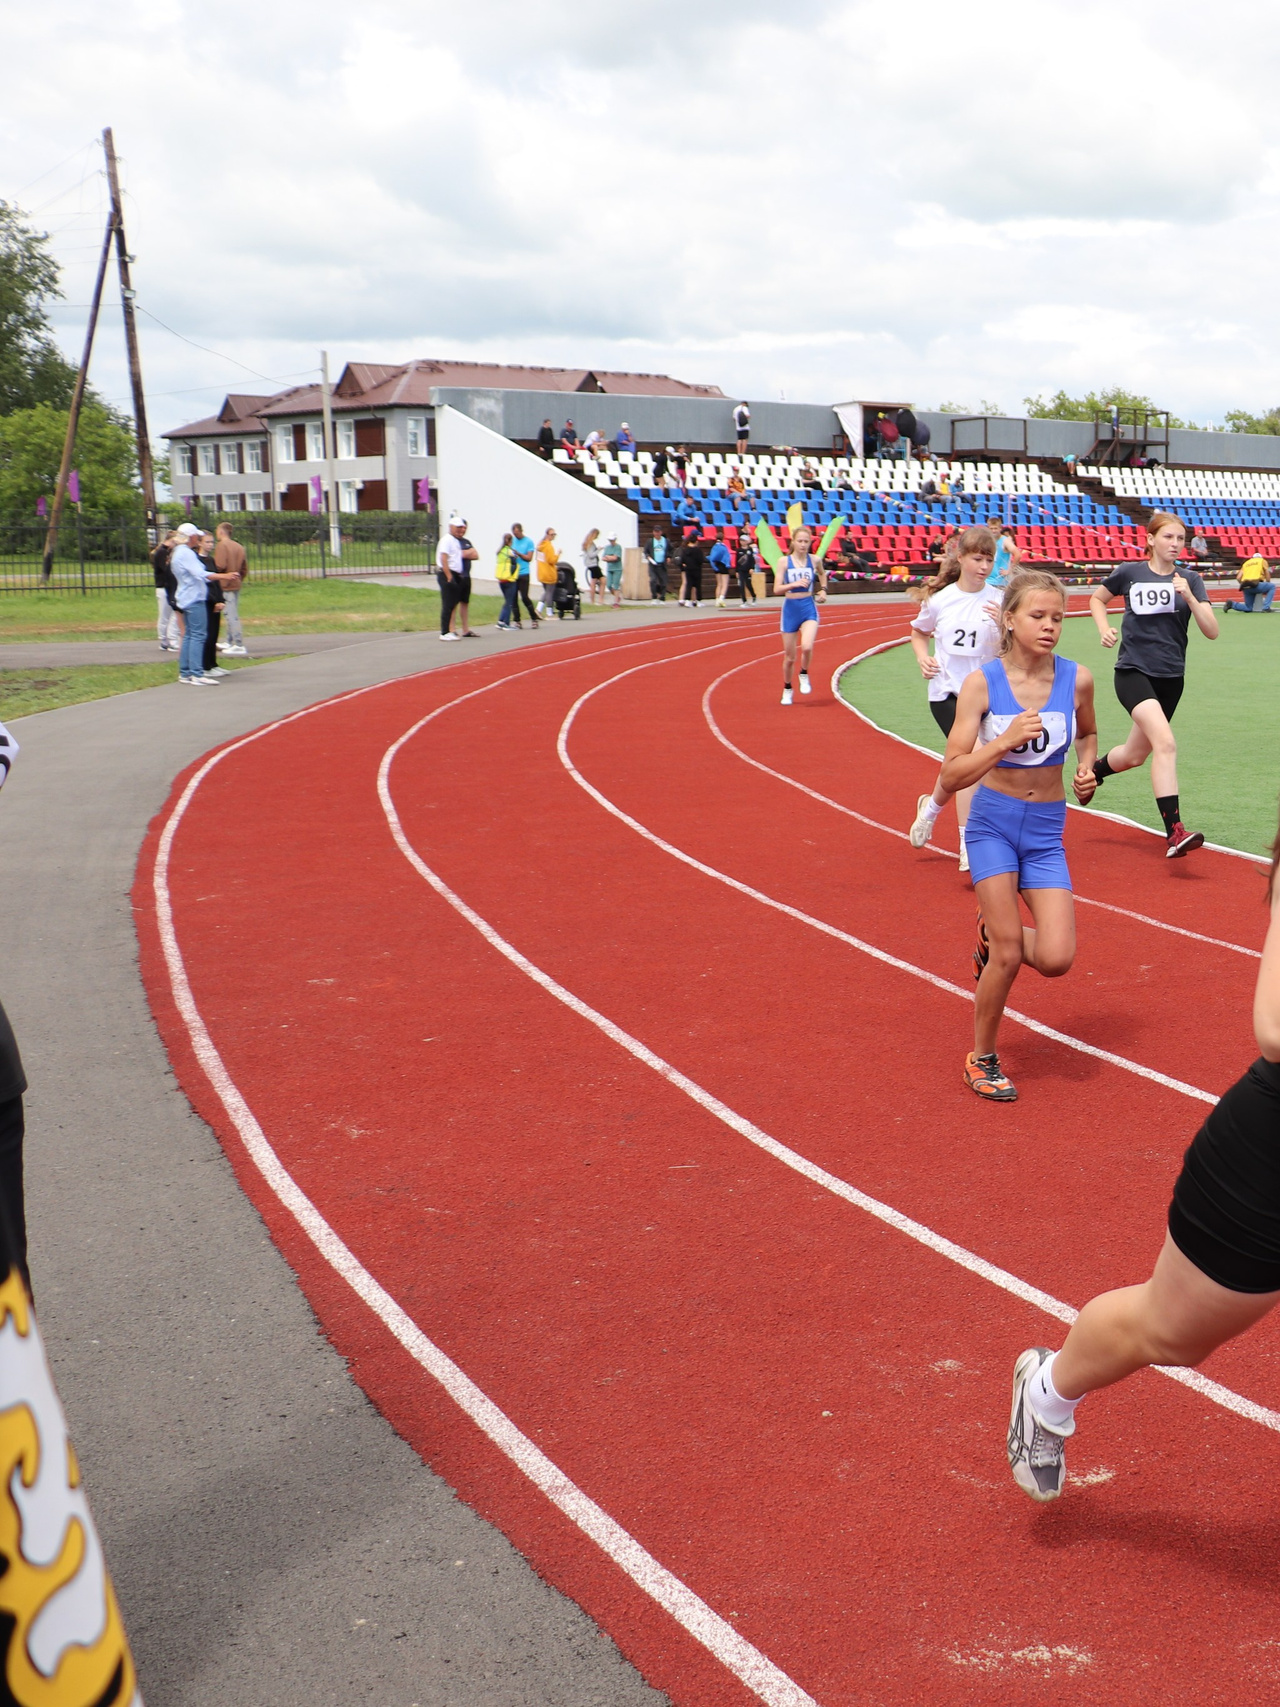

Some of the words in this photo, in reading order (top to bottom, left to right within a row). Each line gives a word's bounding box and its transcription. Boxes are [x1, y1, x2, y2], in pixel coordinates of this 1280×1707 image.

[792, 571, 811, 581] 116
[1135, 589, 1171, 606] 199
[953, 629, 977, 648] 21
